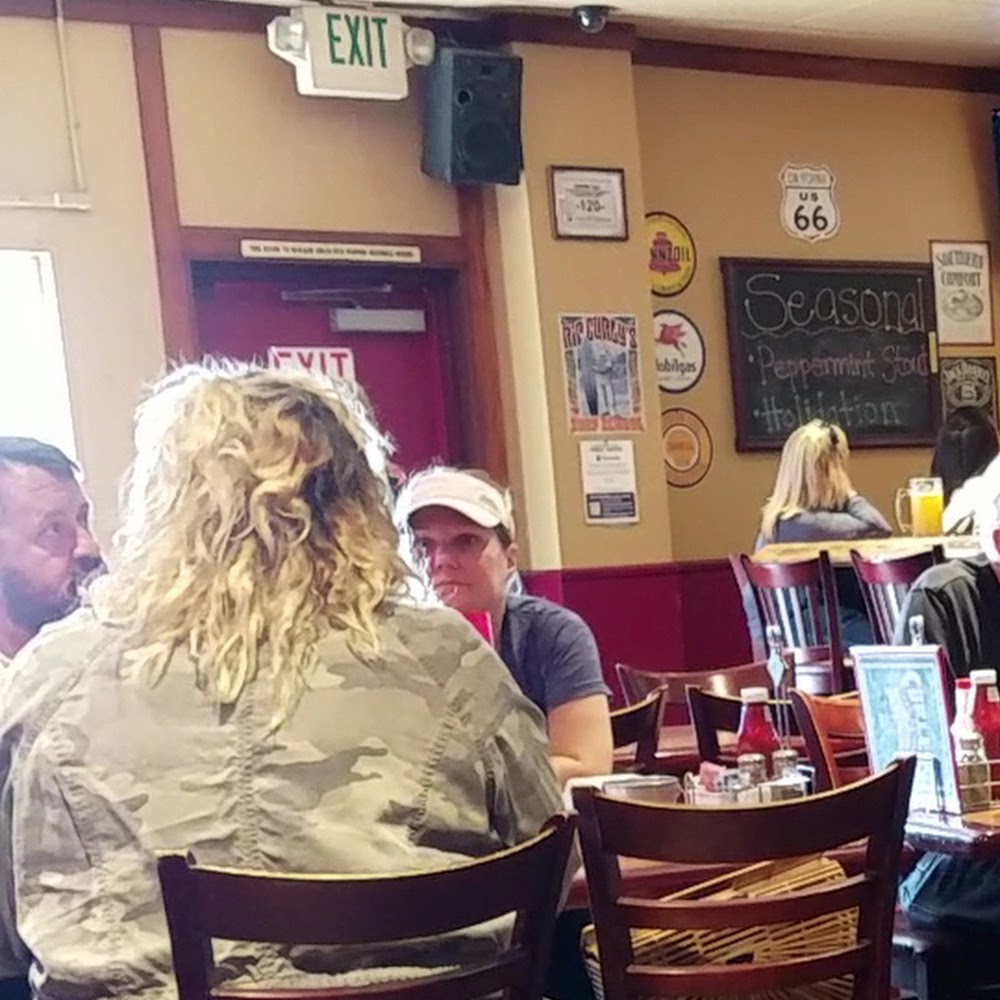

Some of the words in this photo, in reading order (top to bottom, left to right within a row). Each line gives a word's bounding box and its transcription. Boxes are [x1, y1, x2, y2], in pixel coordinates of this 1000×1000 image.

[325, 12, 388, 69] EXIT
[793, 204, 829, 231] 66
[744, 273, 926, 332] Seasonal
[757, 345, 876, 393] Peppermint
